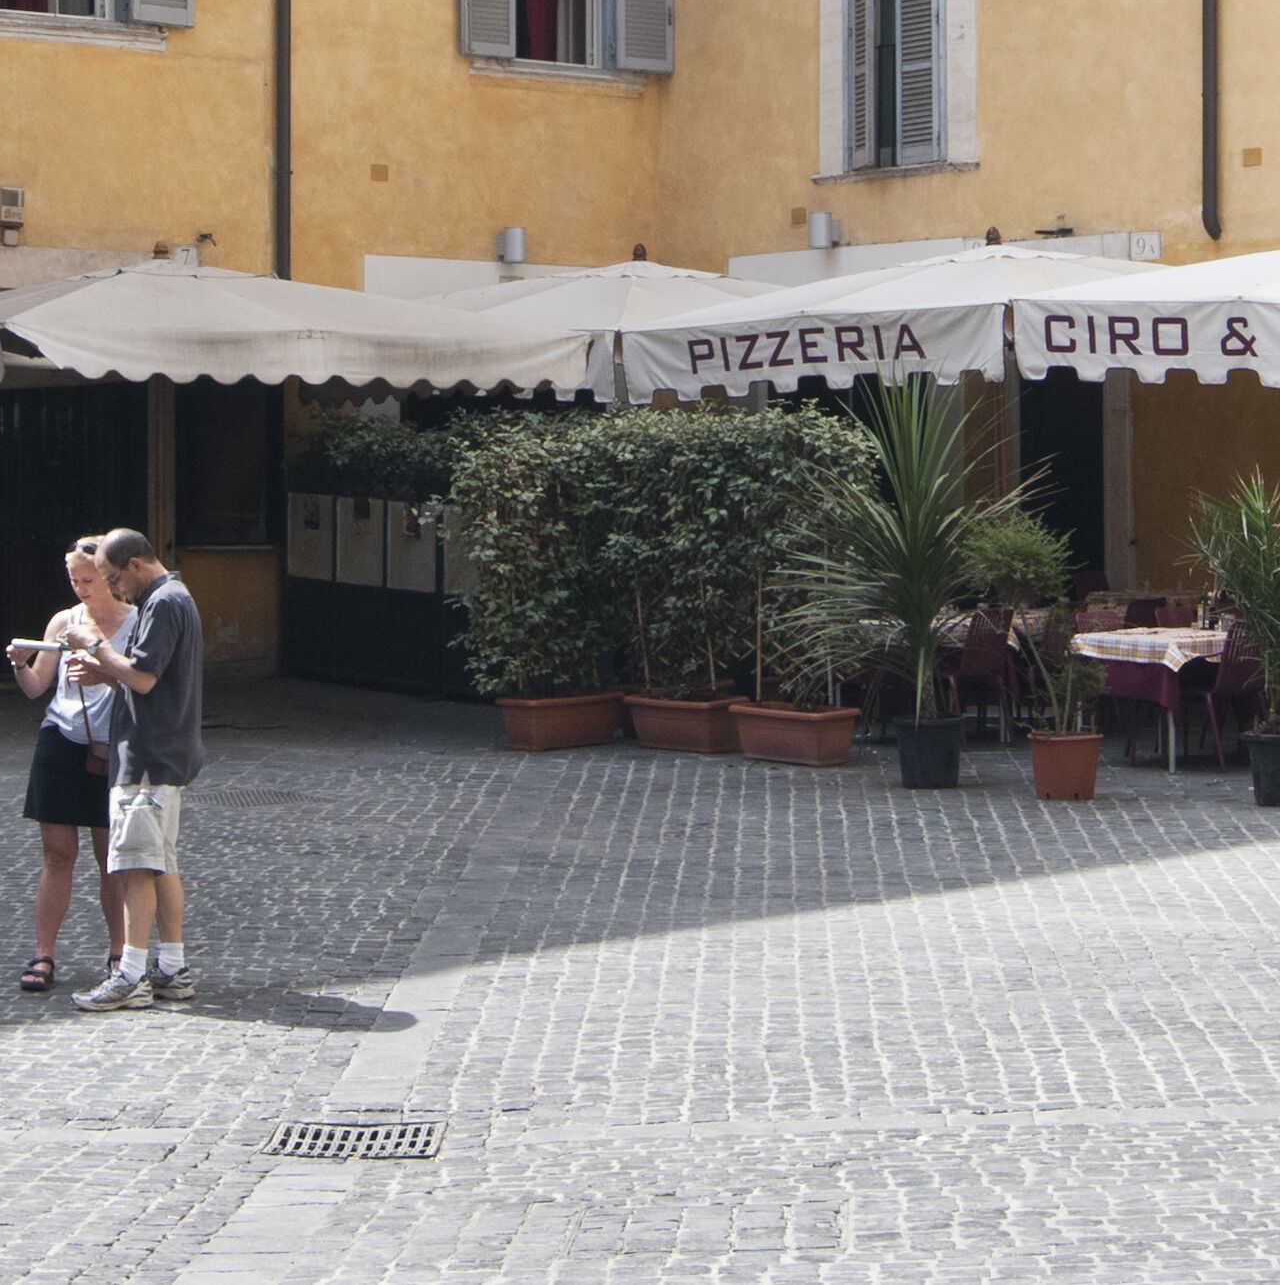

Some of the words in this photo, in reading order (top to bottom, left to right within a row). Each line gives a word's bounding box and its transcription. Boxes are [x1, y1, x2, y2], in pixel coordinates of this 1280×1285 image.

[181, 248, 190, 265] 7
[687, 323, 928, 375] PIZZERIA
[1044, 314, 1189, 356] CIRO
[1220, 316, 1259, 358] &
